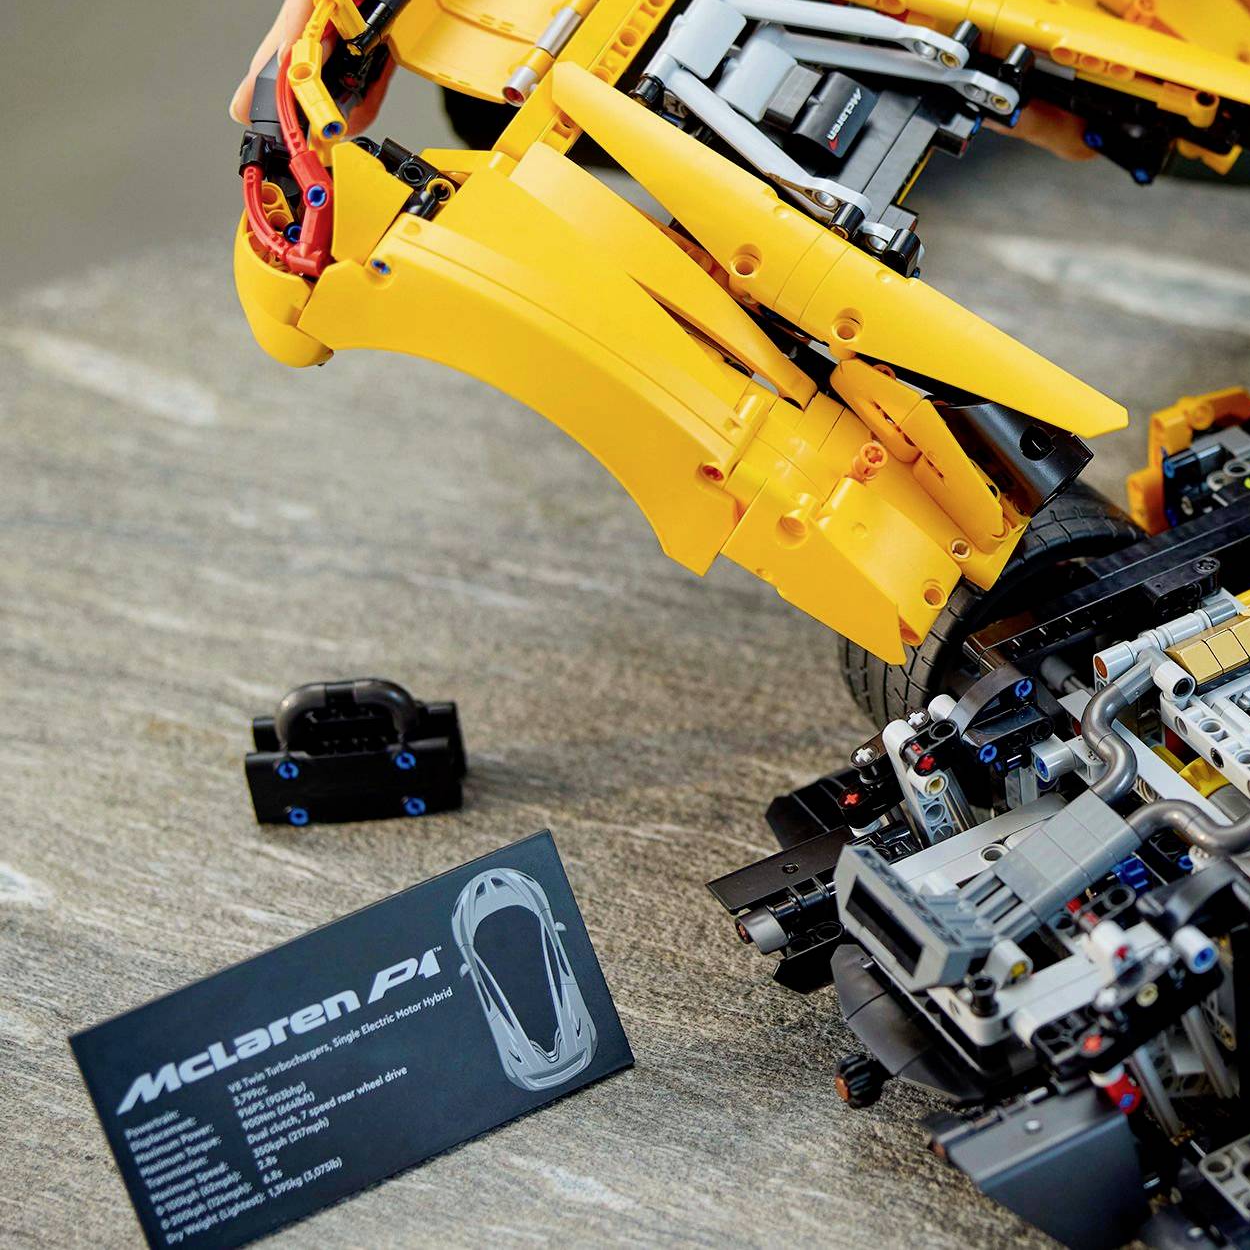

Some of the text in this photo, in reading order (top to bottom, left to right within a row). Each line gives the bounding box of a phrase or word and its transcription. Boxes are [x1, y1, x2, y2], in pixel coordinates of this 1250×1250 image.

[826, 87, 862, 141] McLaren
[241, 1068, 266, 1088] Twin
[264, 1041, 333, 1078] Turbochargers,
[331, 1028, 361, 1049] Single
[360, 1012, 396, 1035] Electric
[394, 1000, 423, 1020] Motor
[422, 986, 454, 1008] Hybrid
[117, 990, 361, 1114] McLaren
[245, 1064, 408, 1145] Dual clutch, 7 speed rear wheel drive
[264, 1080, 307, 1108] (903bhp)
[287, 1116, 330, 1144] (217mph)
[256, 1154, 278, 1171] 2.8s
[261, 1167, 284, 1185] 6.8s
[302, 1155, 344, 1183] (3,075lb)
